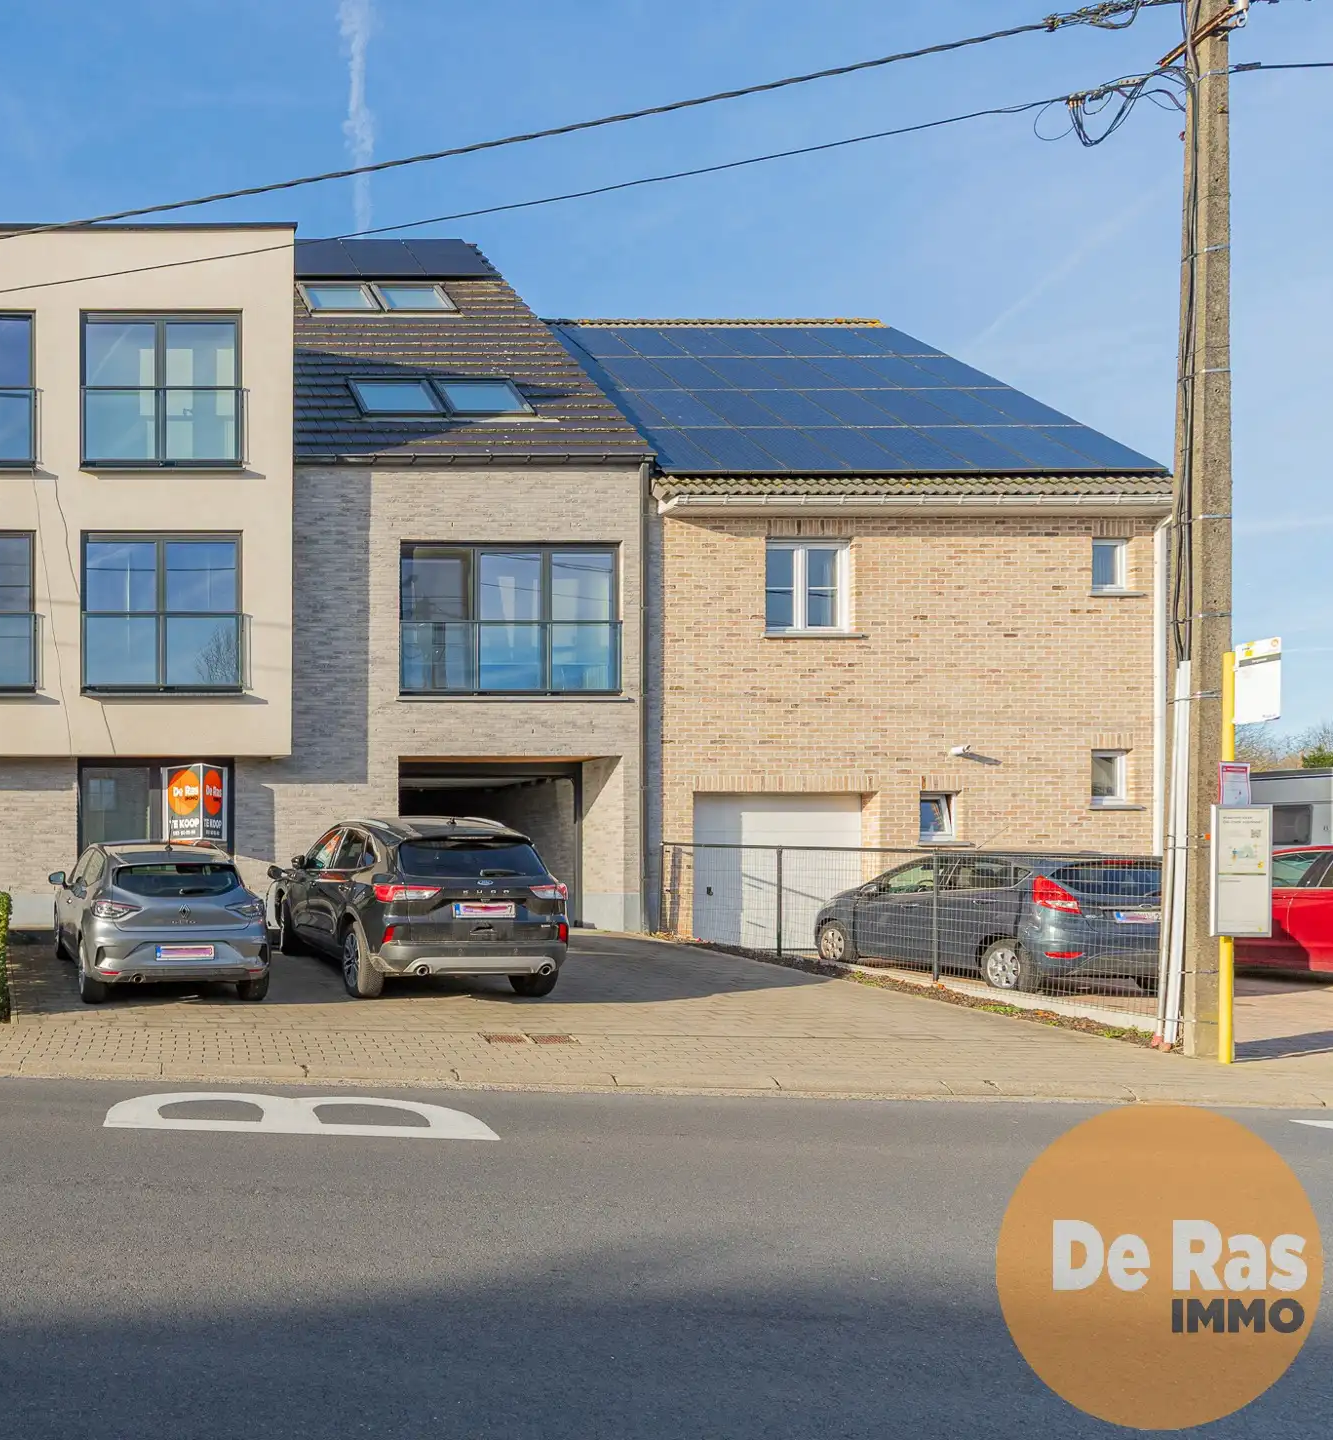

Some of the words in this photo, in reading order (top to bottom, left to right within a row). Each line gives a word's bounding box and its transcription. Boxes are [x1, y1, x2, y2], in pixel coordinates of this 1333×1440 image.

[172, 787, 183, 797] De
[169, 819, 179, 830] TE
[179, 818, 199, 828] KOOP
